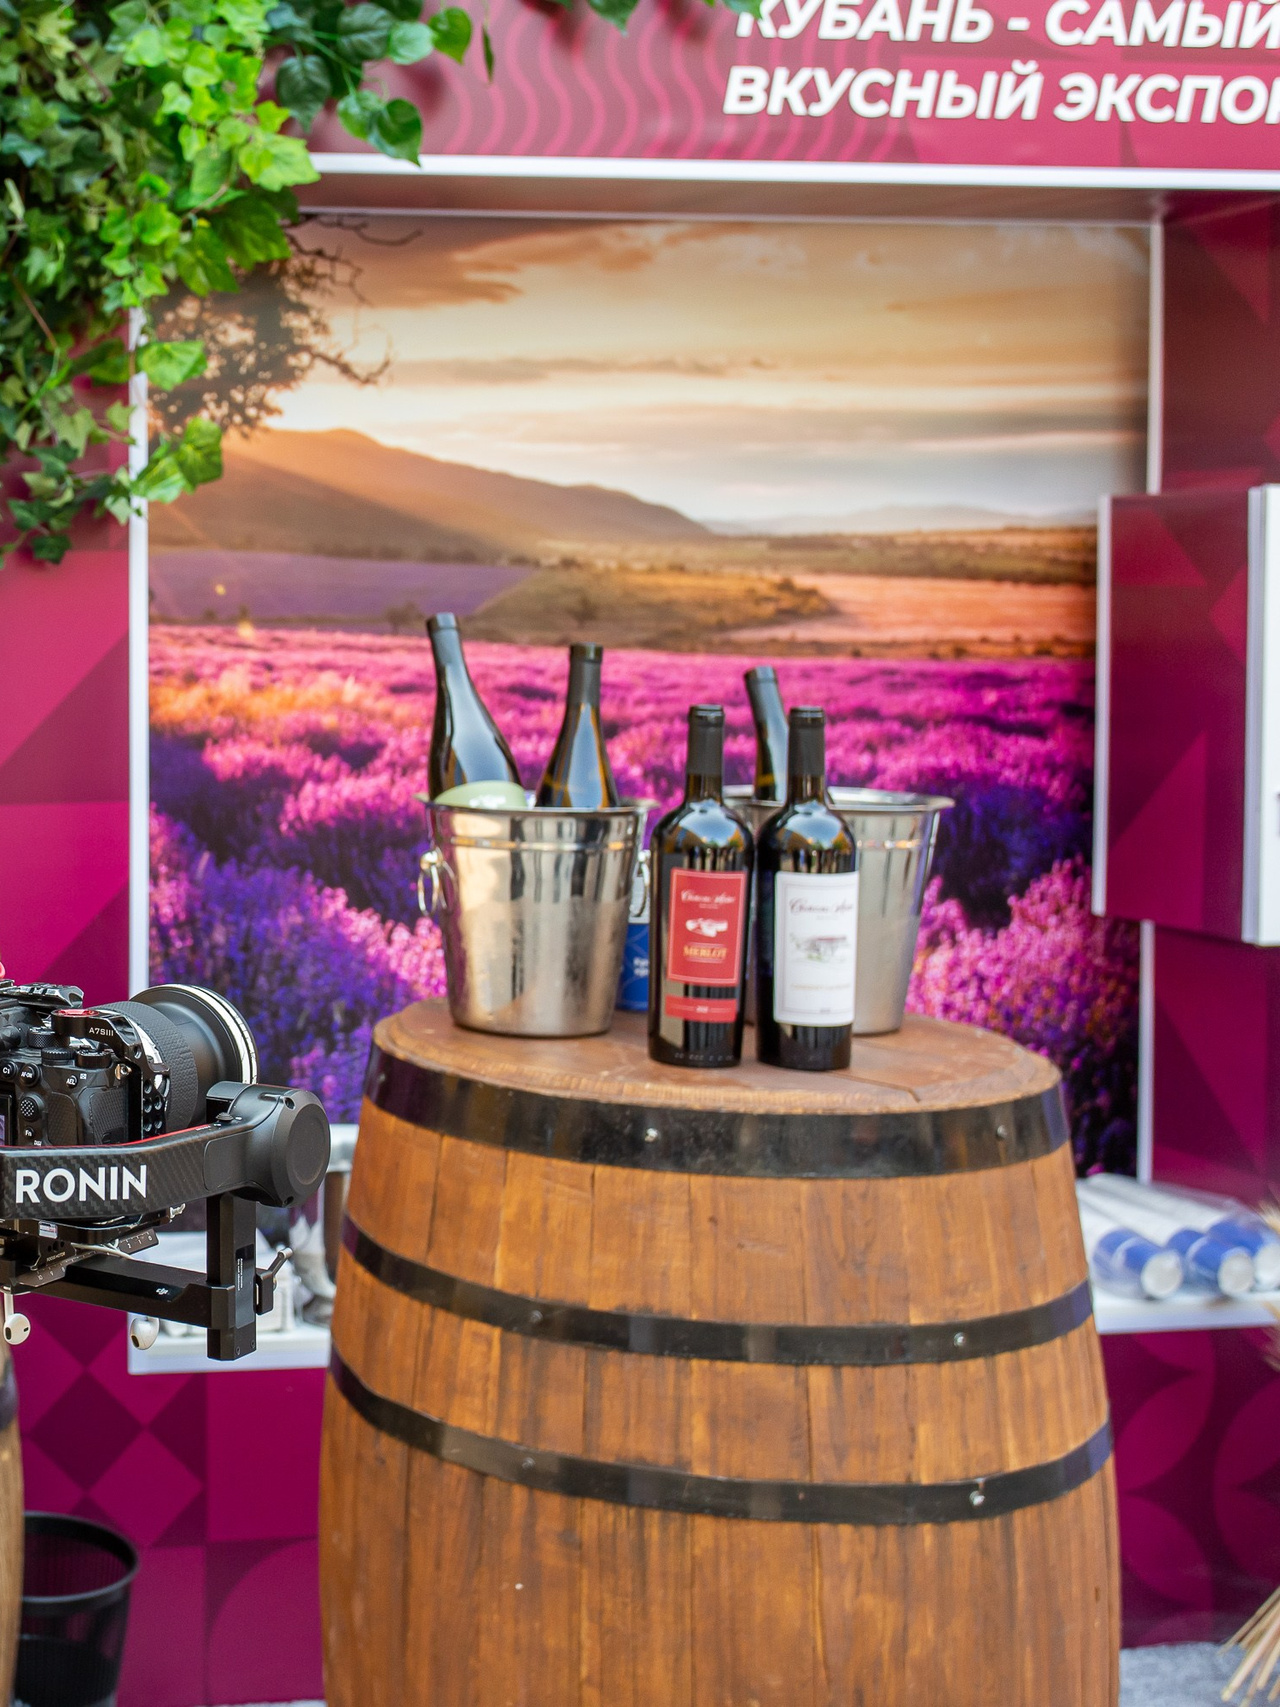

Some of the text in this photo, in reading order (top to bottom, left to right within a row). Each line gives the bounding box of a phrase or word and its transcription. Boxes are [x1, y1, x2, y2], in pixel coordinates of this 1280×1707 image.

[735, 0, 1280, 49] КУБАНЬ - САМЫЙ
[723, 60, 1044, 121] ВКУСНЫЙ
[88, 1027, 114, 1037] A7SIII
[2, 1067, 11, 1075] C1
[15, 1164, 147, 1203] RONIN
